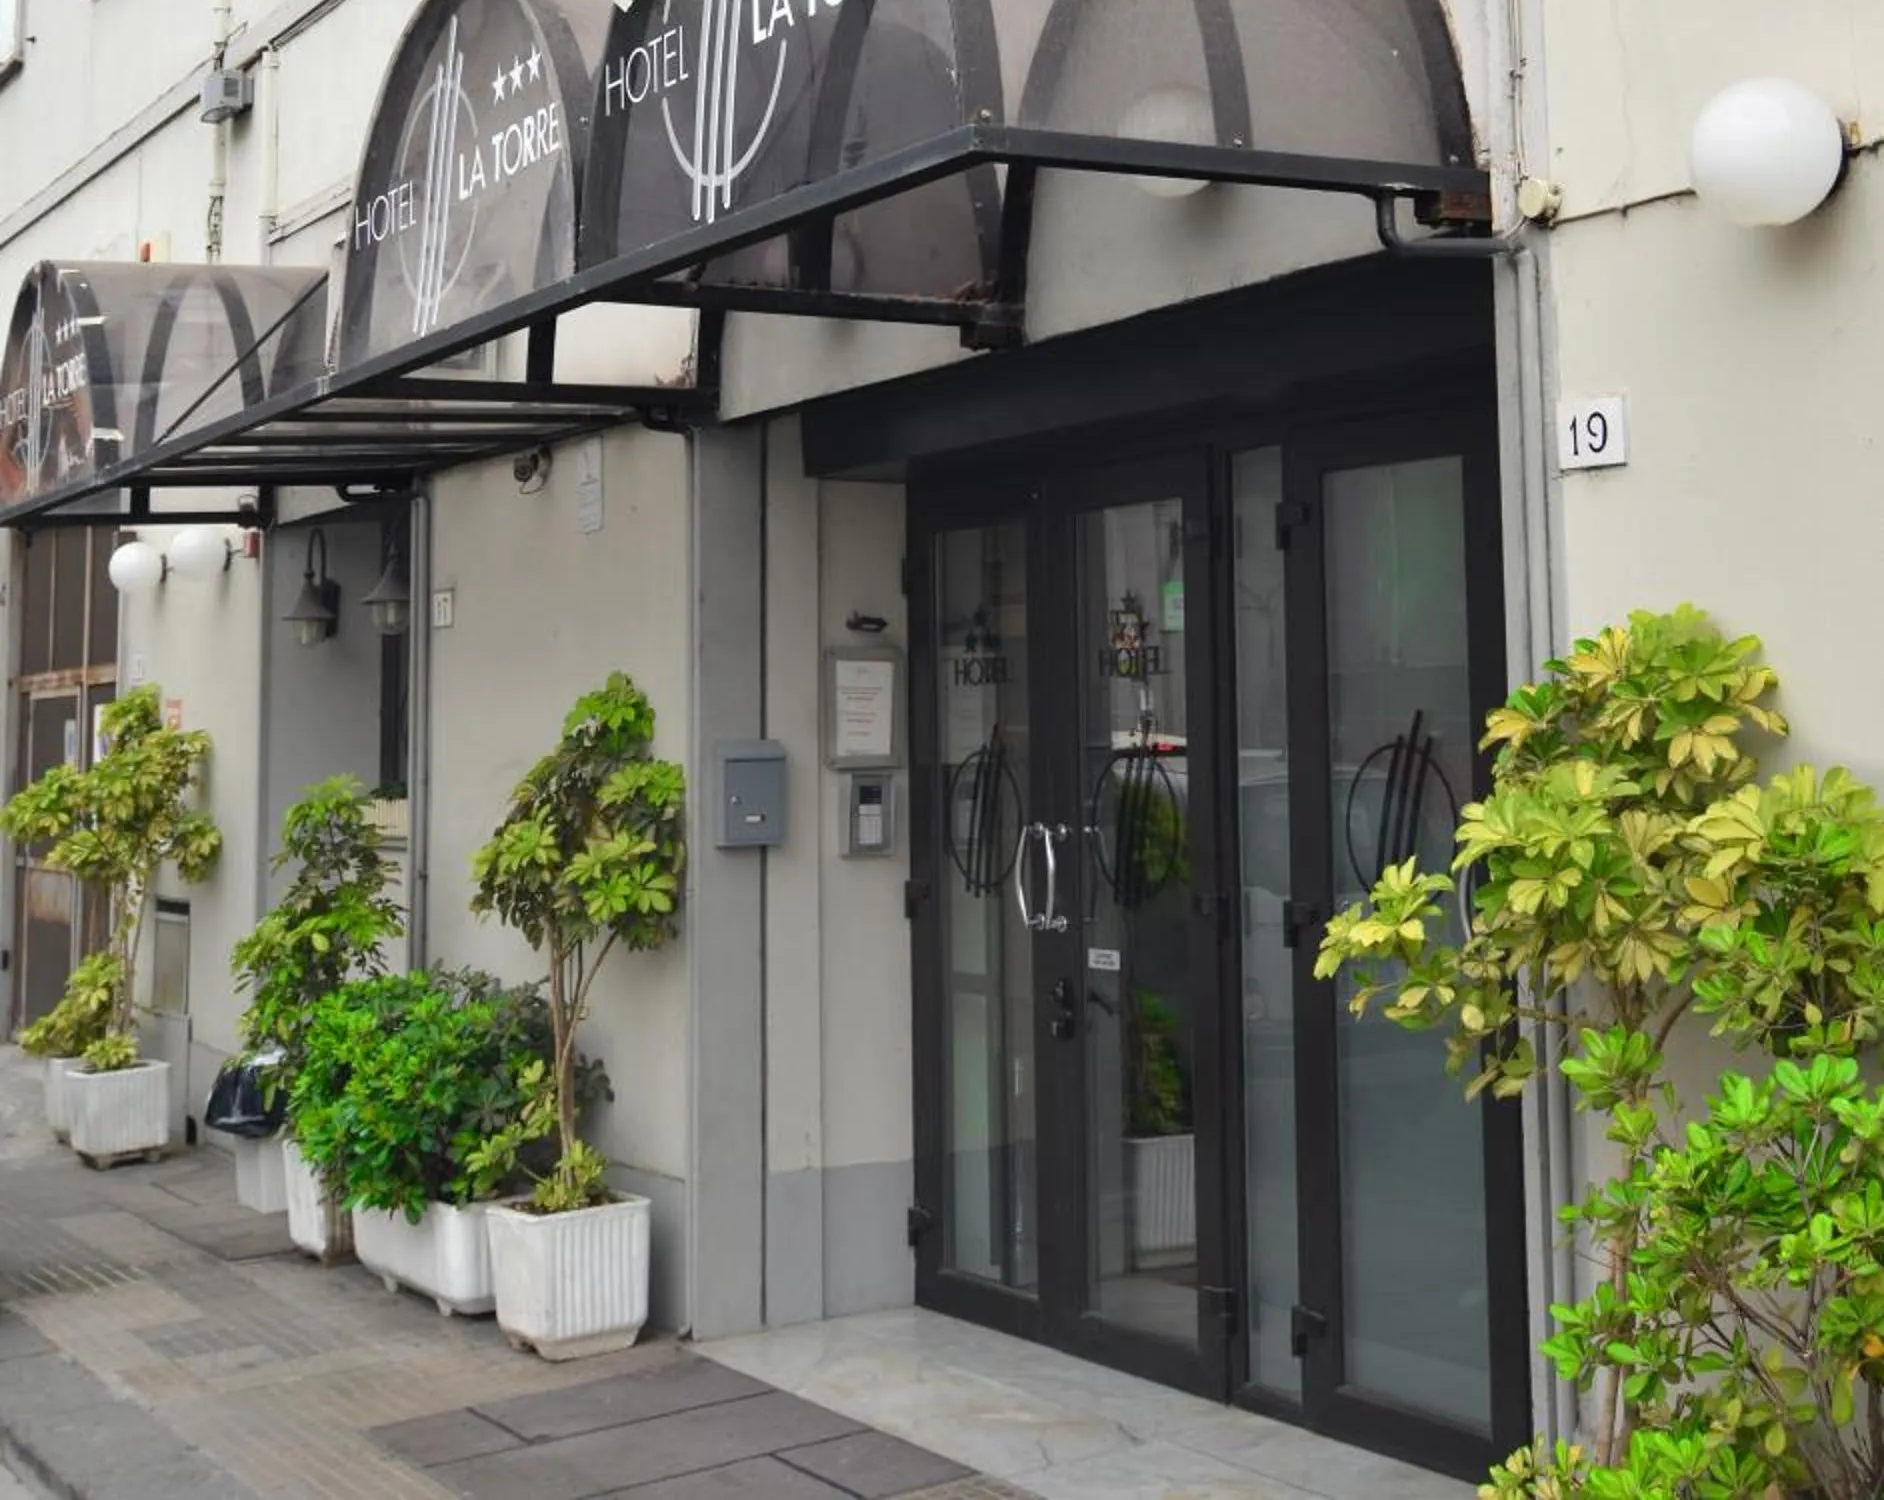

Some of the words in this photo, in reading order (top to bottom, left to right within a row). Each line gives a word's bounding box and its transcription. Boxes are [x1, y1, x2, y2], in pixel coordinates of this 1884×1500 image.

[604, 25, 689, 117] HOTEL
[355, 179, 417, 250] HOTEL
[458, 145, 487, 202] LA
[492, 103, 560, 176] TORRE
[1569, 411, 1607, 456] 19
